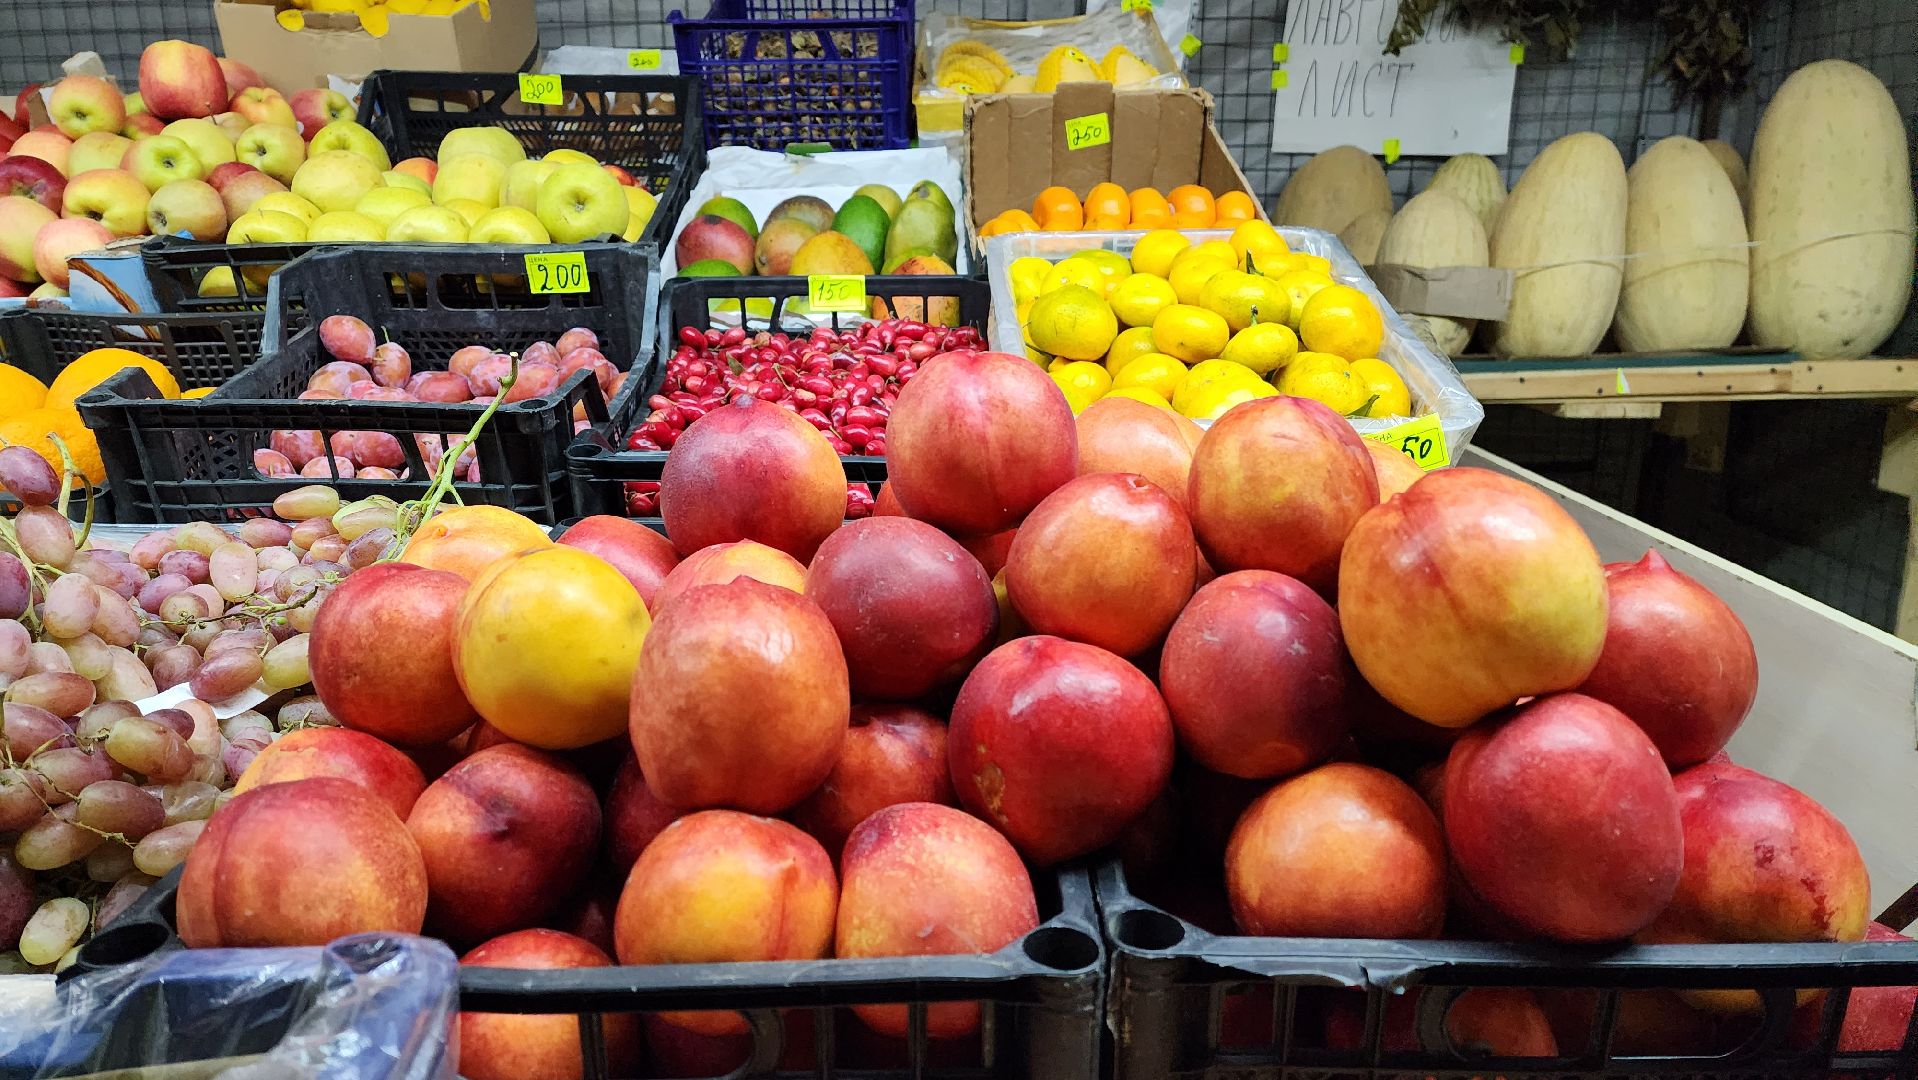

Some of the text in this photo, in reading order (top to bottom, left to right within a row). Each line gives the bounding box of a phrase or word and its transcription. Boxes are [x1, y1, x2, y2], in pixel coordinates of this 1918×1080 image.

[527, 80, 554, 99] 200
[1299, 60, 1415, 118] ЛИСТ
[1073, 126, 1101, 145] 250
[538, 264, 580, 291] 200
[818, 281, 850, 301] 150
